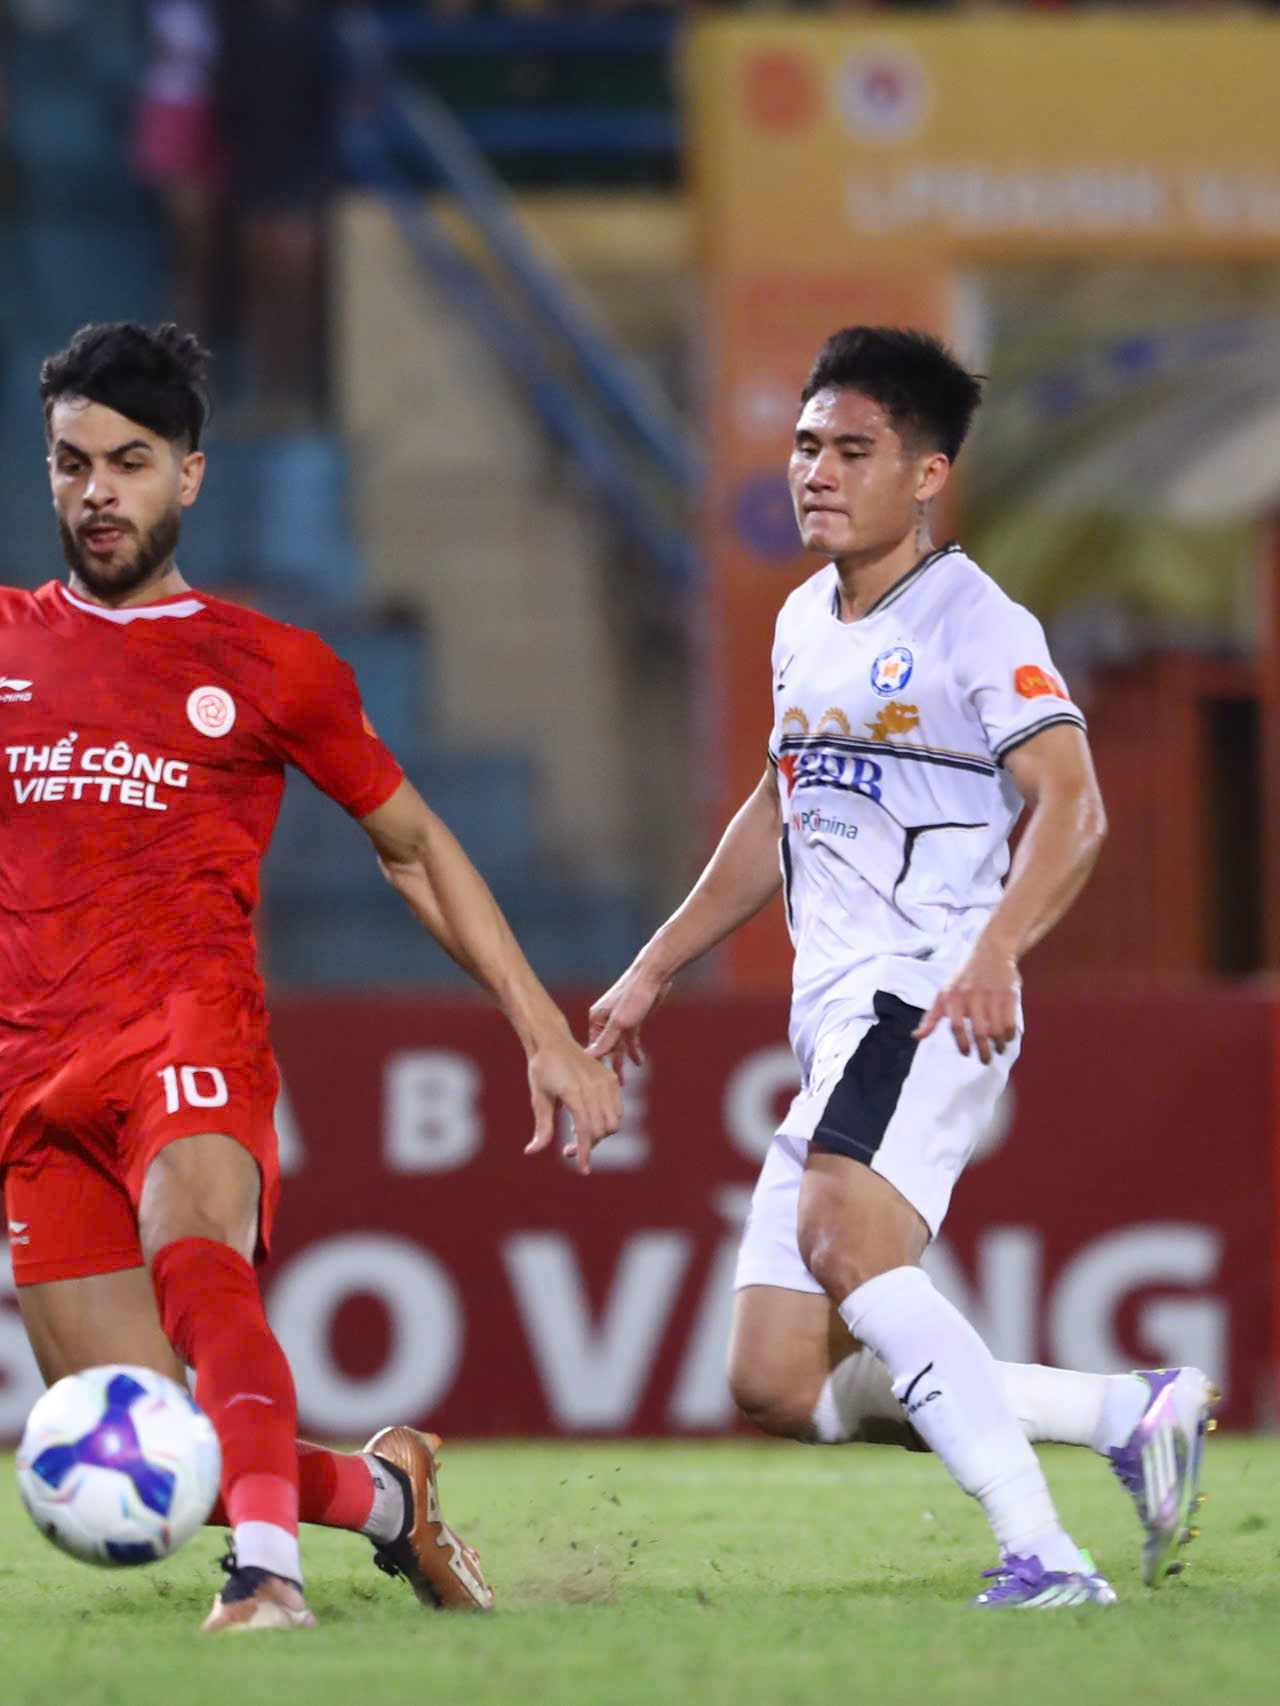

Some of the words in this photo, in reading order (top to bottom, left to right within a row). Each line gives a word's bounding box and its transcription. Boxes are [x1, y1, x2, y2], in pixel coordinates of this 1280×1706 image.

[5, 731, 79, 773] THỂ
[81, 741, 190, 788] CÔNG
[12, 776, 168, 811] VIETTEL
[157, 1063, 229, 1115] 10
